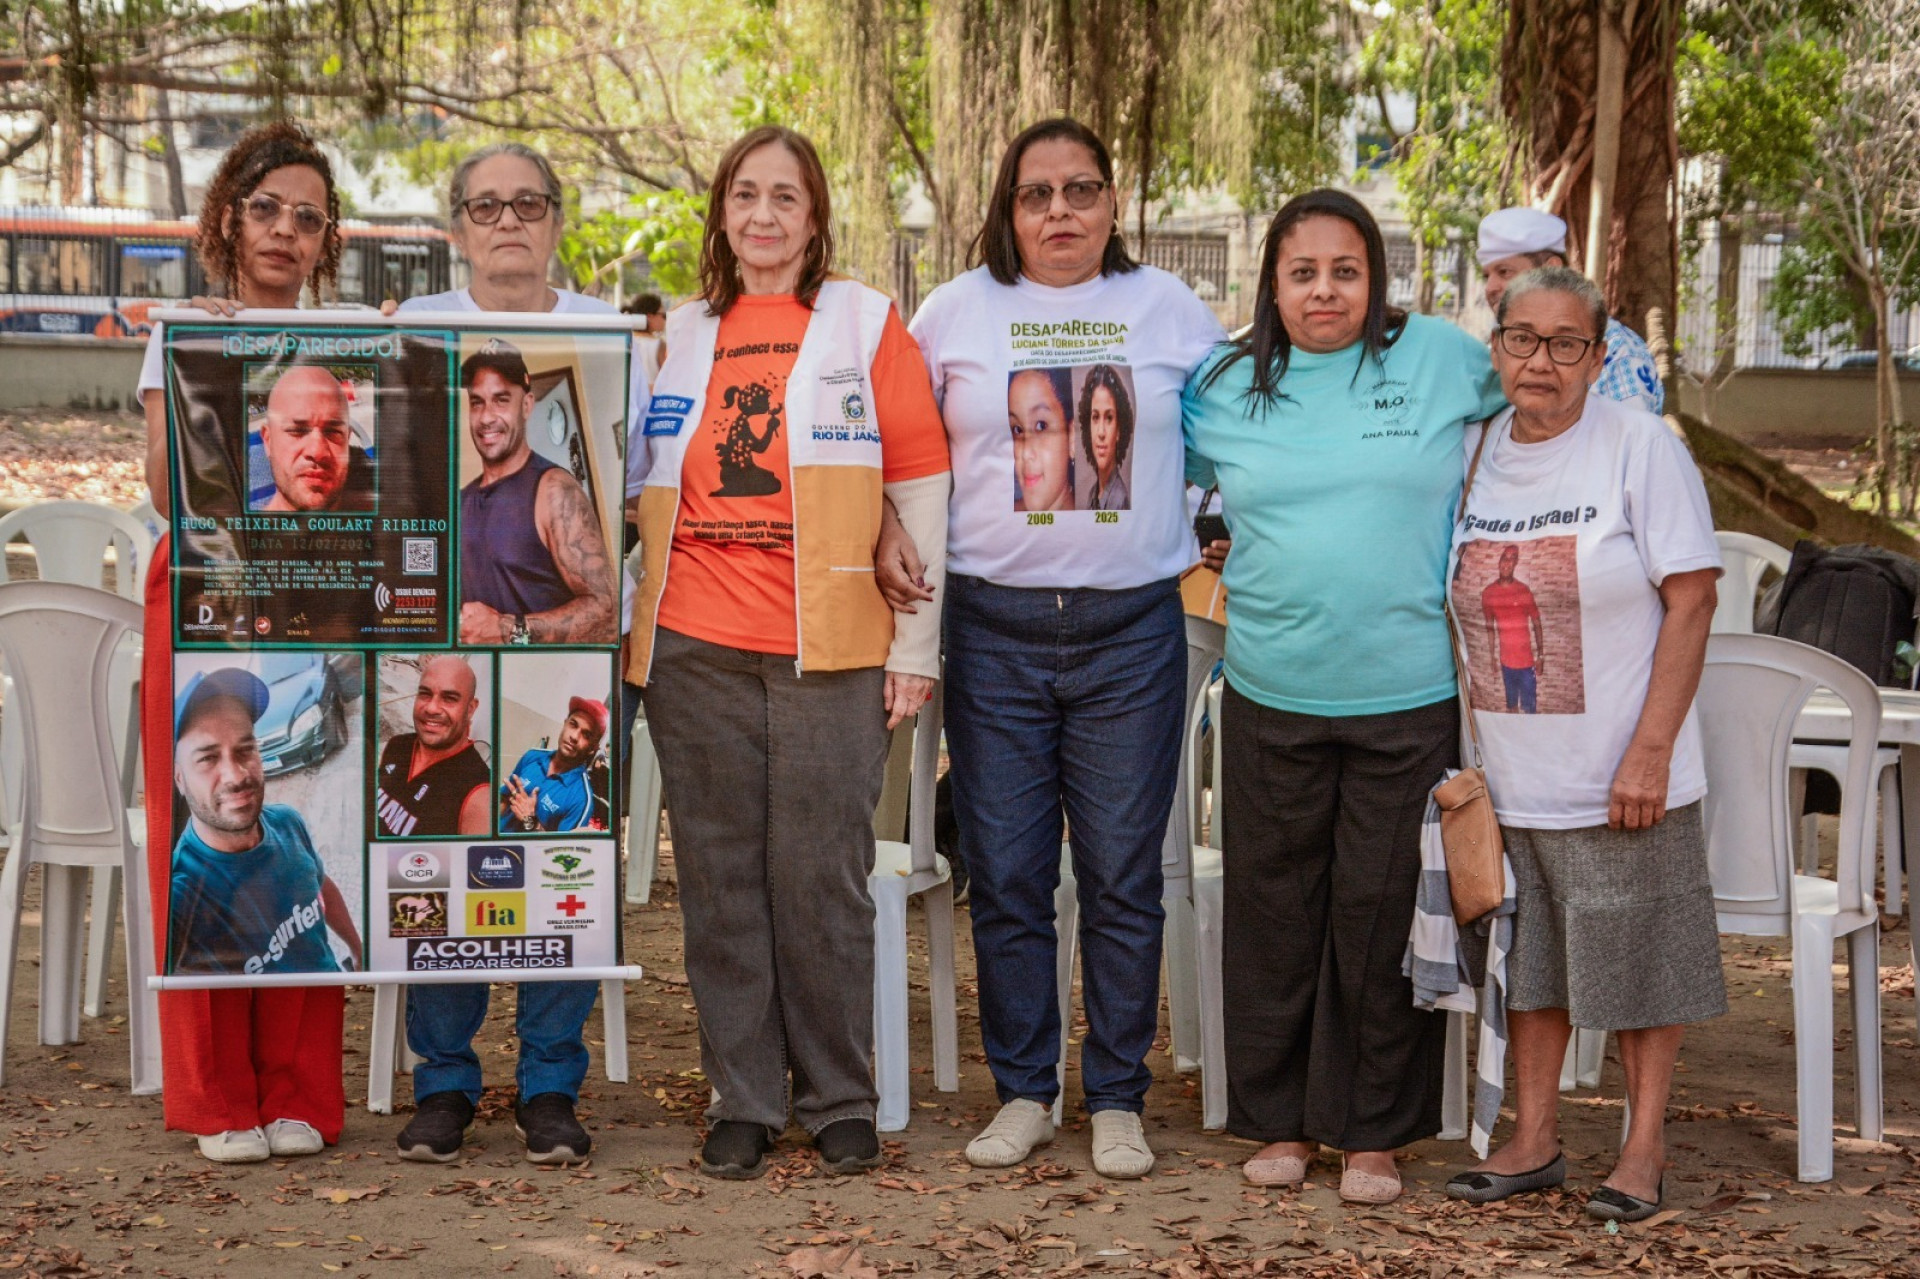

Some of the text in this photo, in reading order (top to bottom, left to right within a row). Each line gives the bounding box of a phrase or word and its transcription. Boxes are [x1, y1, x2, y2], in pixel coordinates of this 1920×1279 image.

[1011, 319, 1128, 337] DESAPARECIDA
[1012, 335, 1125, 349] LUCIANE TORRES DA SILVA
[727, 342, 770, 358] conhece
[773, 342, 799, 354] essa
[812, 431, 833, 441] RIO
[836, 431, 849, 441] DE
[1361, 429, 1420, 440] ANA PAULA
[180, 516, 447, 532] HUGO TEIXEIRA GOULART RIBEIRO
[1027, 512, 1054, 525] 2009
[1095, 511, 1118, 523] 2025
[1514, 520, 1525, 532] o
[1529, 506, 1581, 531] Israel
[251, 538, 372, 551] DATA 12/02/2024
[395, 588, 412, 596] DISQUE
[395, 596, 416, 607] 2253
[199, 604, 214, 624] D
[405, 869, 433, 878] CICR
[475, 899, 516, 926] fia
[244, 898, 320, 974] e-surfer
[412, 939, 566, 958] ACOLHER
[413, 956, 566, 970] DESAPARECIDOS
